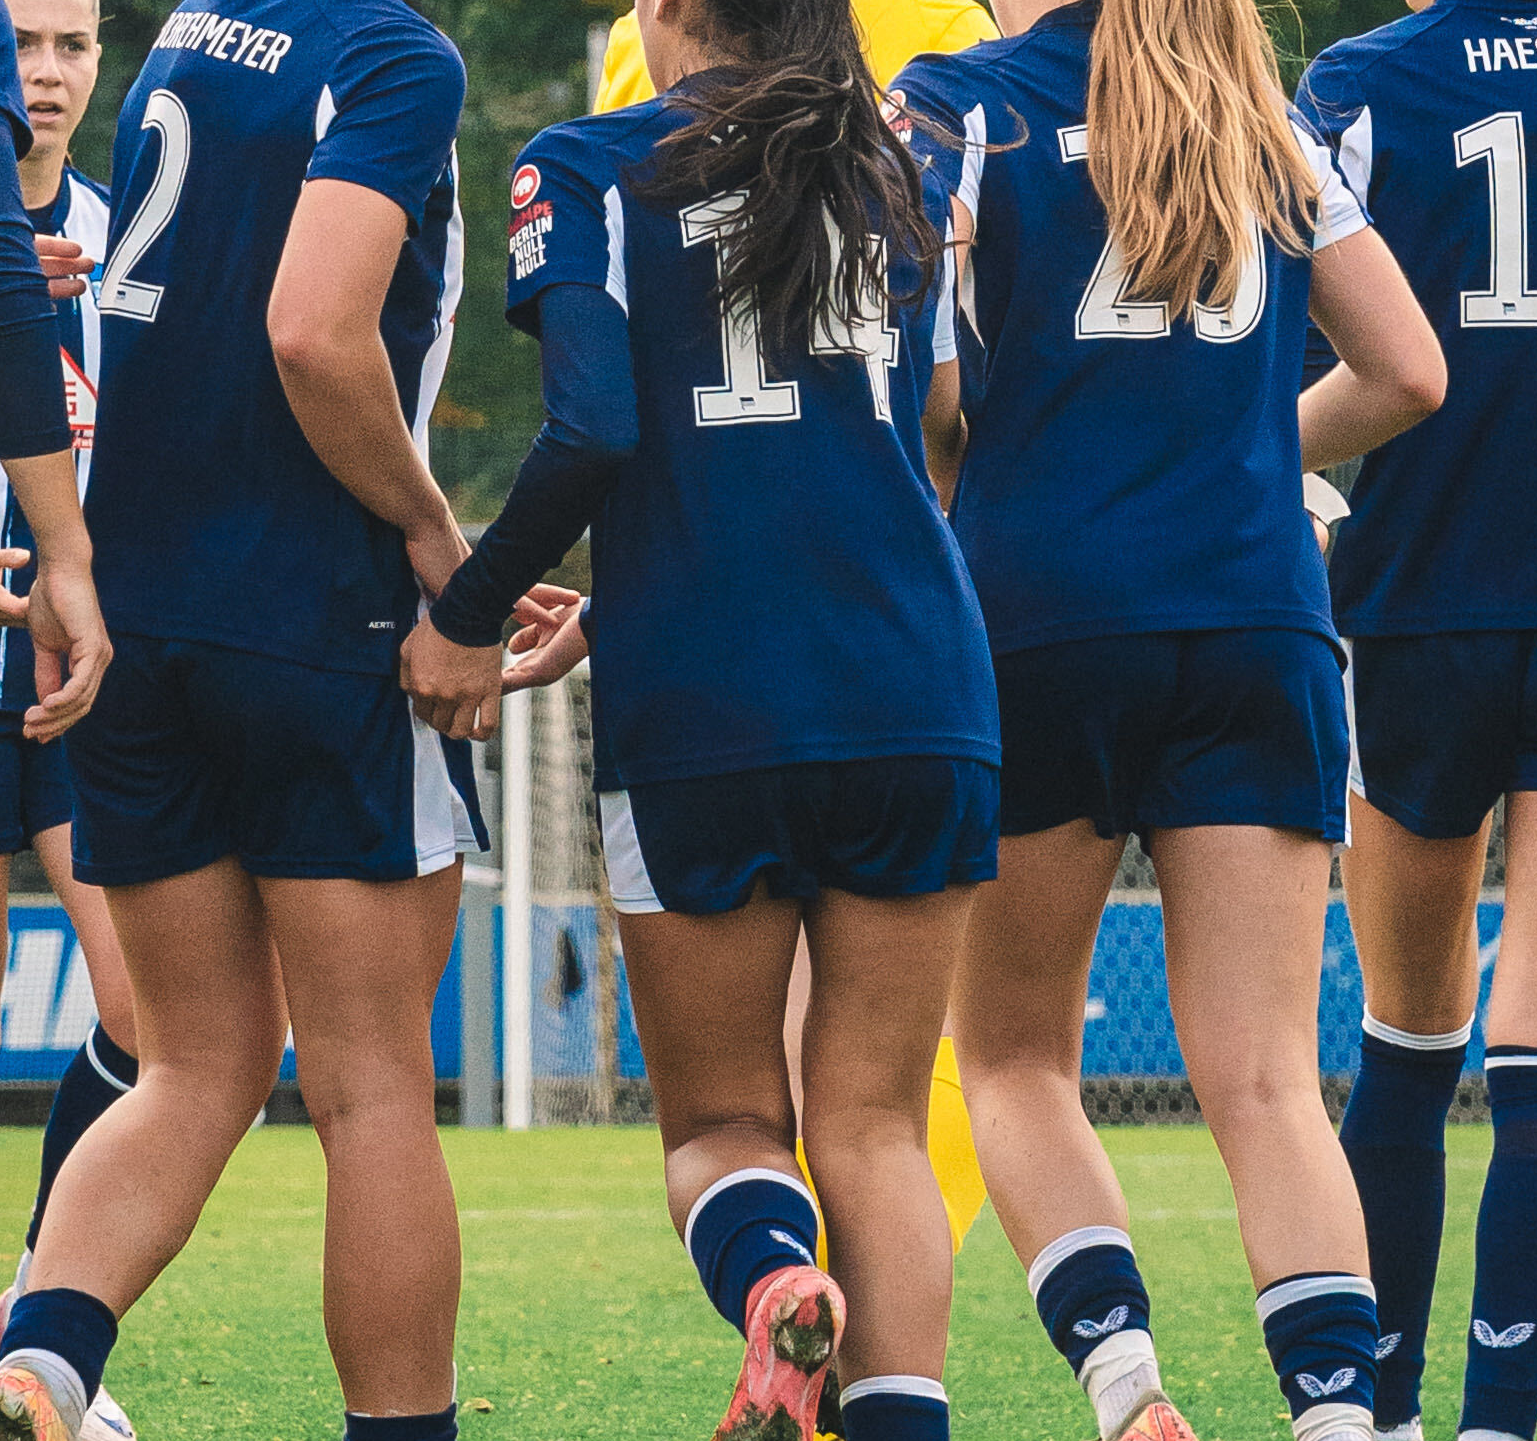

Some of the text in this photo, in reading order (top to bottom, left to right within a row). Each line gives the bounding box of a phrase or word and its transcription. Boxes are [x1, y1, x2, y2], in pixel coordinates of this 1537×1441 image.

[509, 215, 553, 254] BERLIN
[514, 235, 546, 266] NULL
[515, 250, 547, 281] NULL
[679, 187, 899, 426] 14
